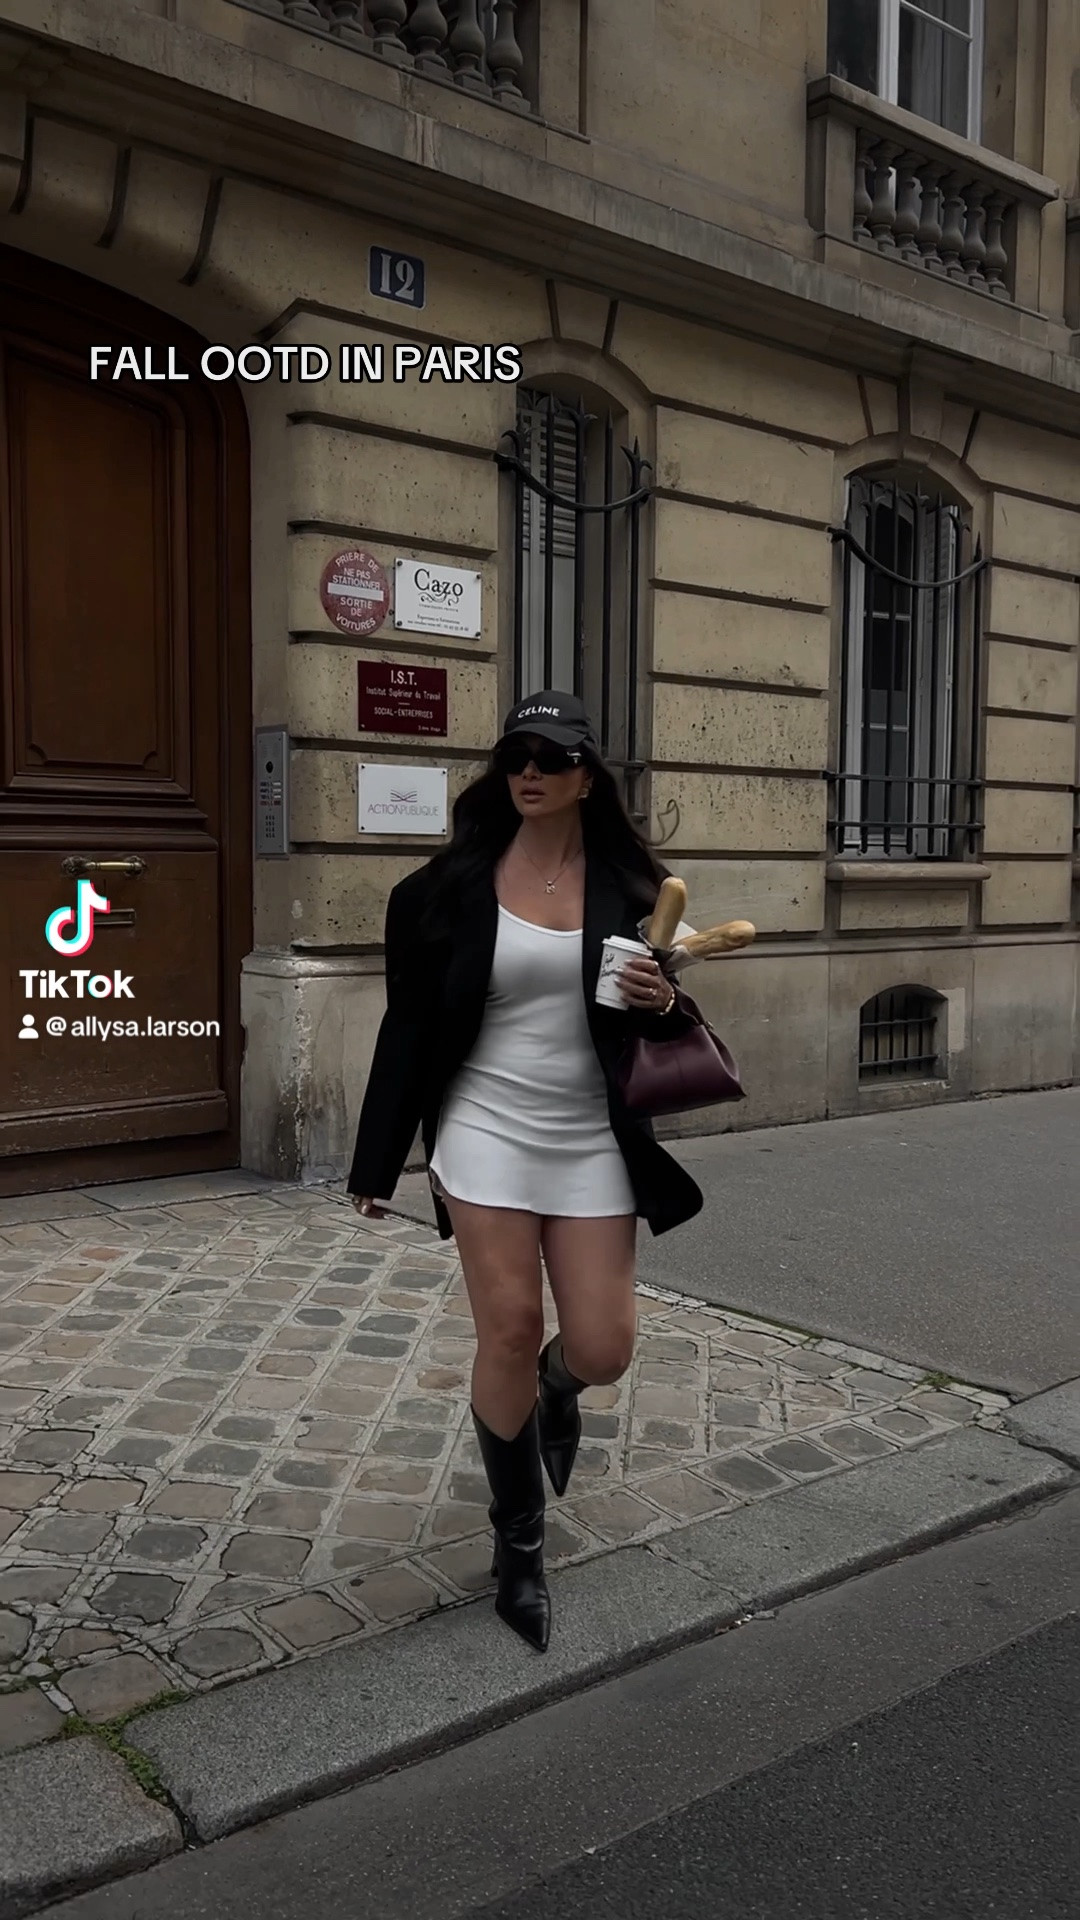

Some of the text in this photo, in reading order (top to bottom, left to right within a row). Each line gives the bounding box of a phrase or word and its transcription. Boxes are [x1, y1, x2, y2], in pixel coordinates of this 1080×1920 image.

[379, 252, 416, 300] 12
[343, 567, 371, 580] NE PAS
[367, 559, 380, 573] DE
[332, 574, 381, 591] STATIONNER
[414, 568, 463, 598] Cazo
[340, 597, 373, 610] SORTIE
[350, 607, 362, 617] DE
[336, 612, 377, 631] VOITURES
[390, 669, 418, 686] I.S.T.
[517, 705, 560, 719] CELINE
